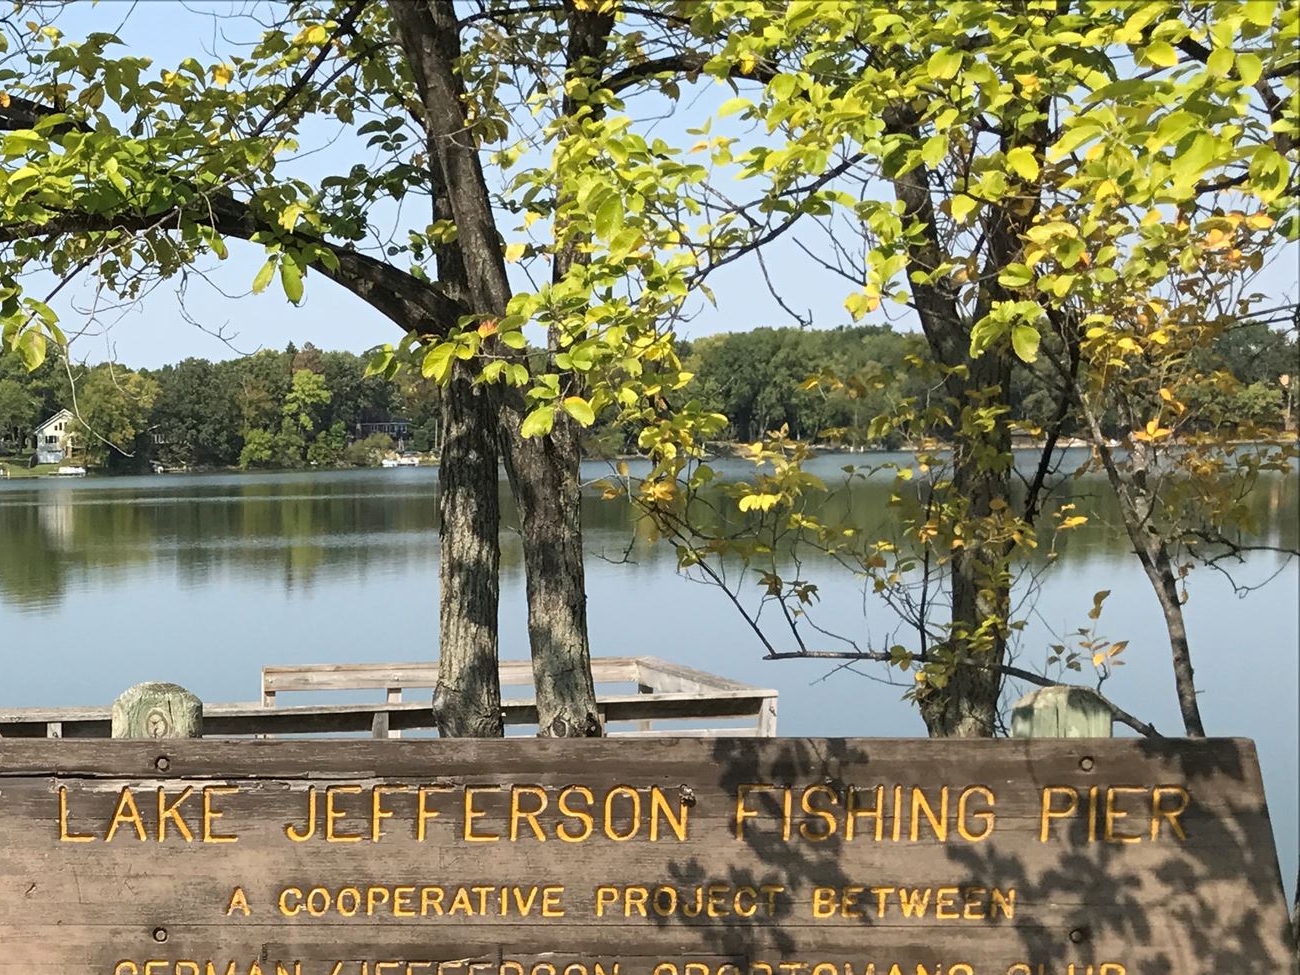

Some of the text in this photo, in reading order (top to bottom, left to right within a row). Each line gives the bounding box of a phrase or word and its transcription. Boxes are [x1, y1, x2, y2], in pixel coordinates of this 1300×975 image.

[56, 781, 1191, 844] LAKE JEFFERSON FISHING PIER
[226, 885, 1017, 919] A COOPERATIVE PROJECT BETWEEN
